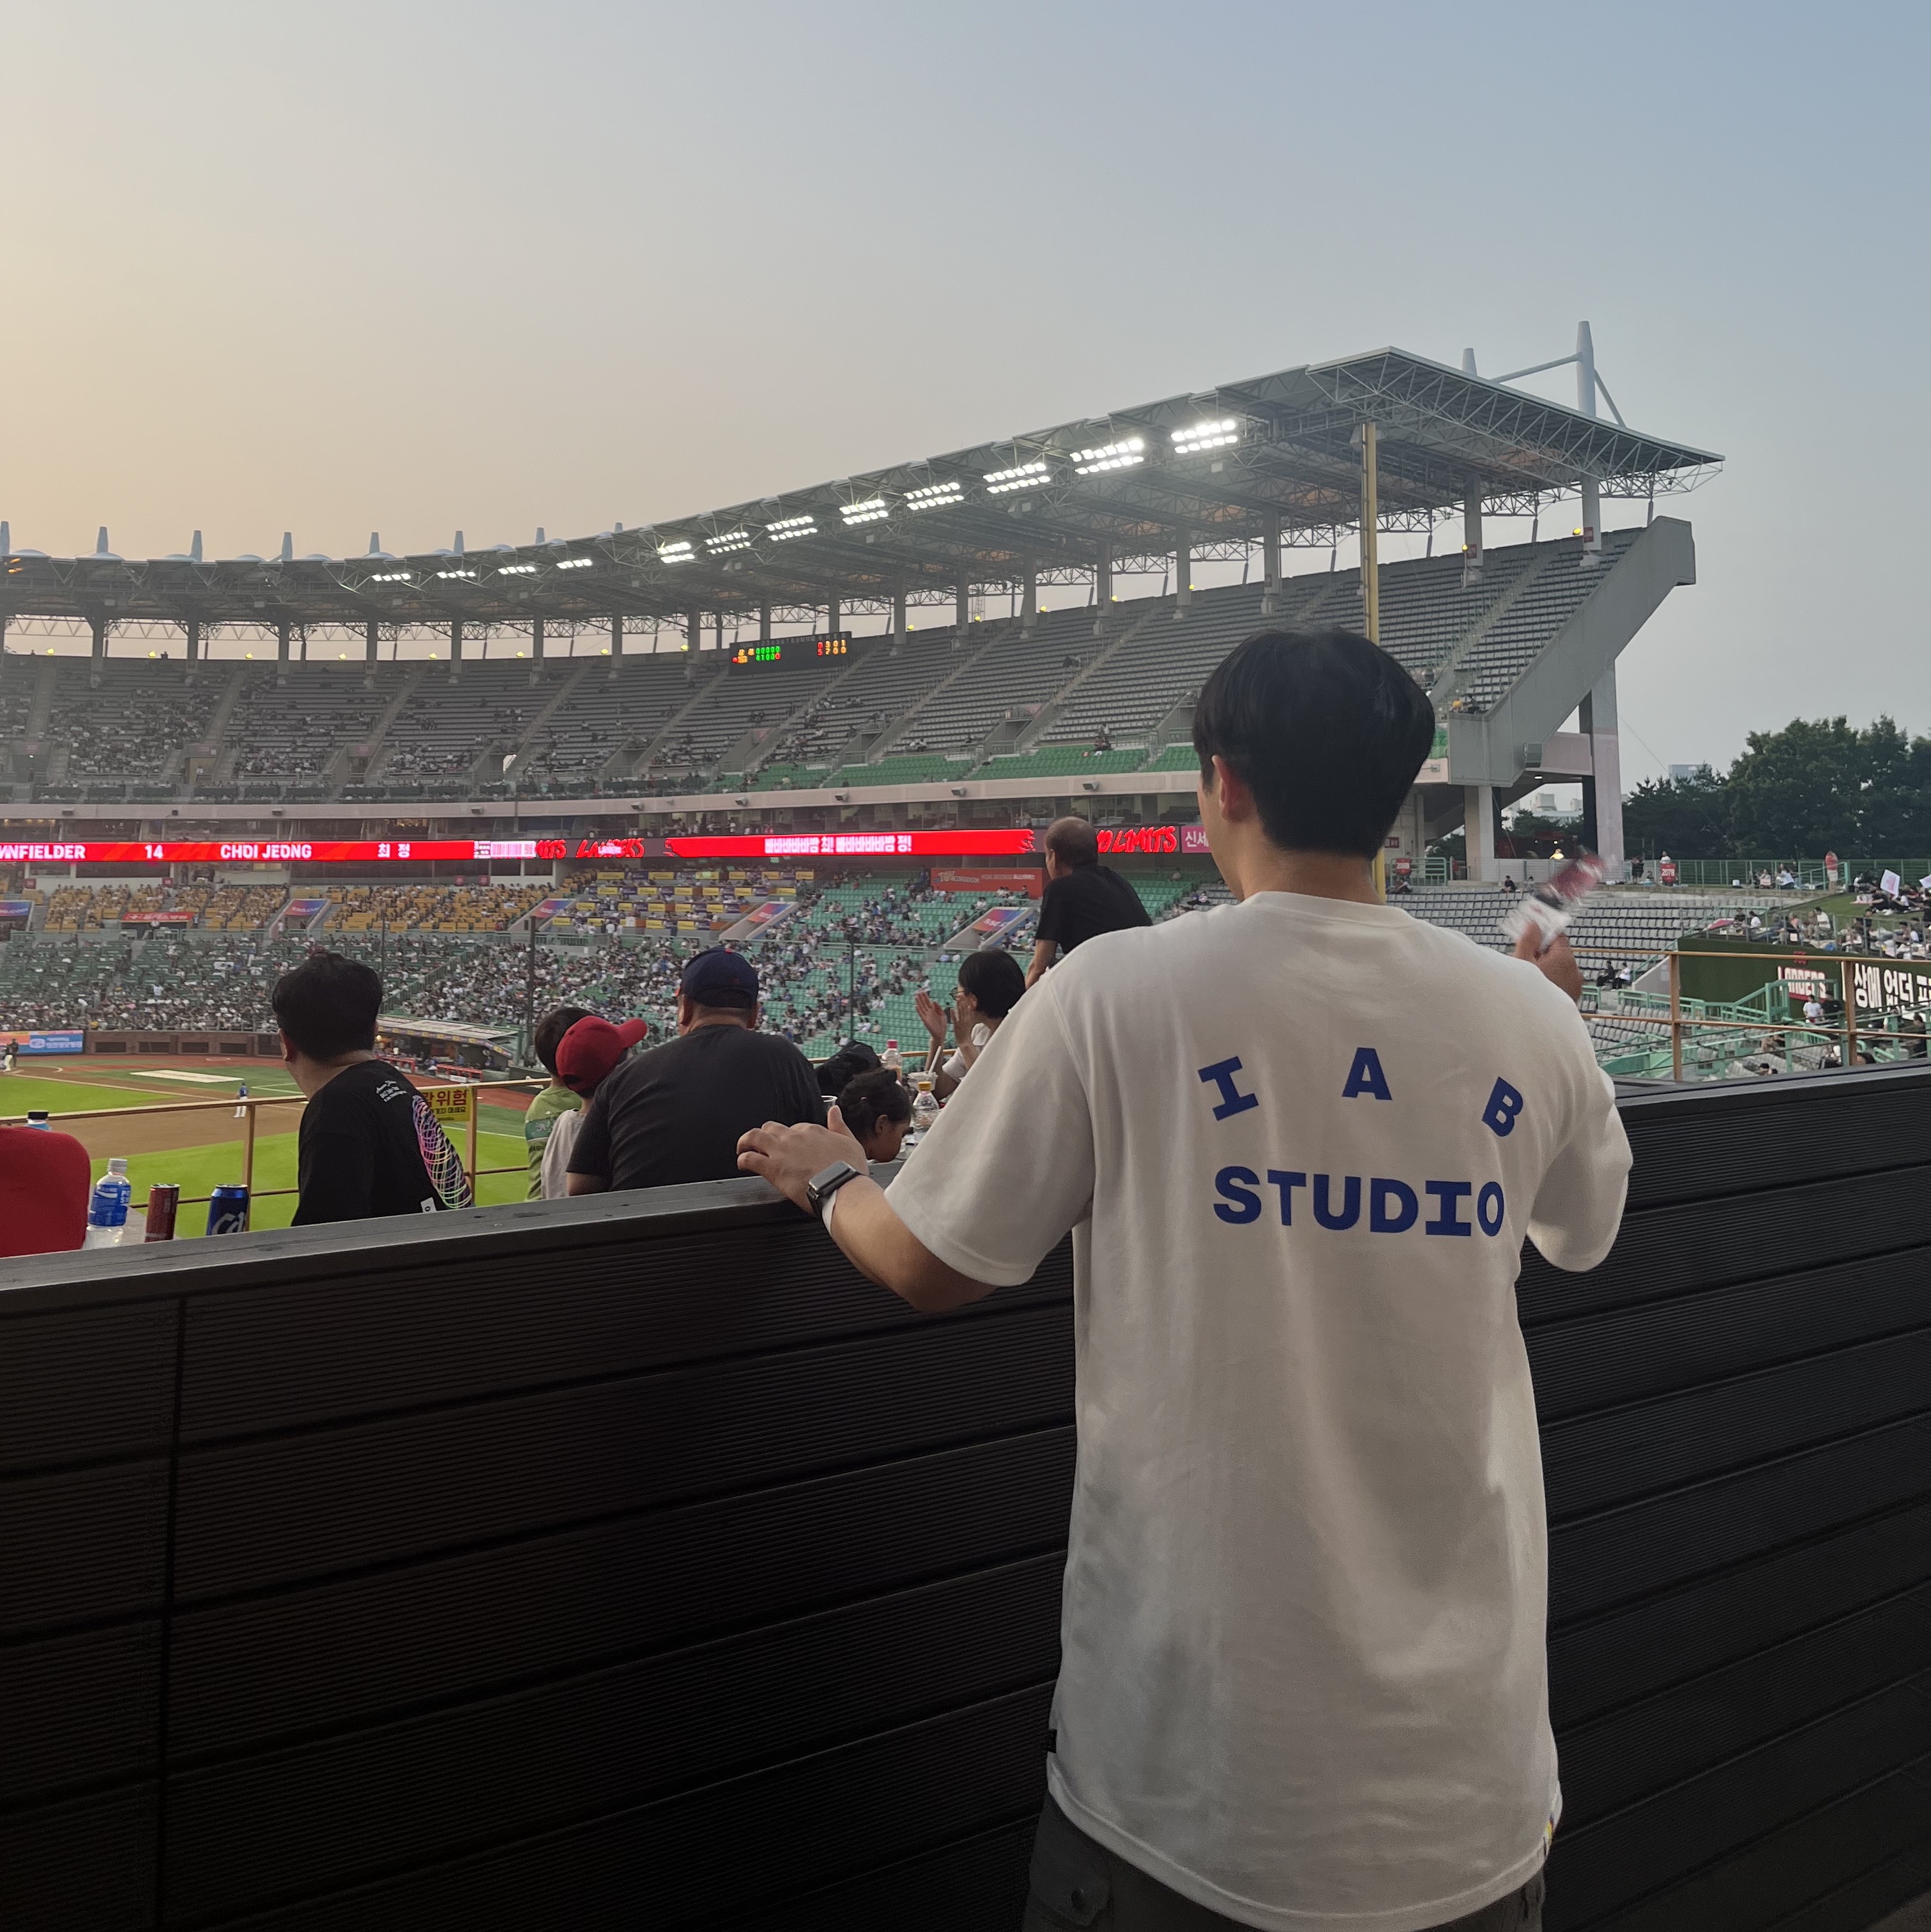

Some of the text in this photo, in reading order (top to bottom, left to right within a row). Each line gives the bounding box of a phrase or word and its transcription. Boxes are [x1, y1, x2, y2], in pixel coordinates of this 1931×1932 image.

[145, 845, 164, 859] 14
[220, 844, 258, 859] CHOI
[262, 844, 312, 859] JEONG
[398, 843, 411, 858] 정
[1213, 1166, 1504, 1237] STUDIO
